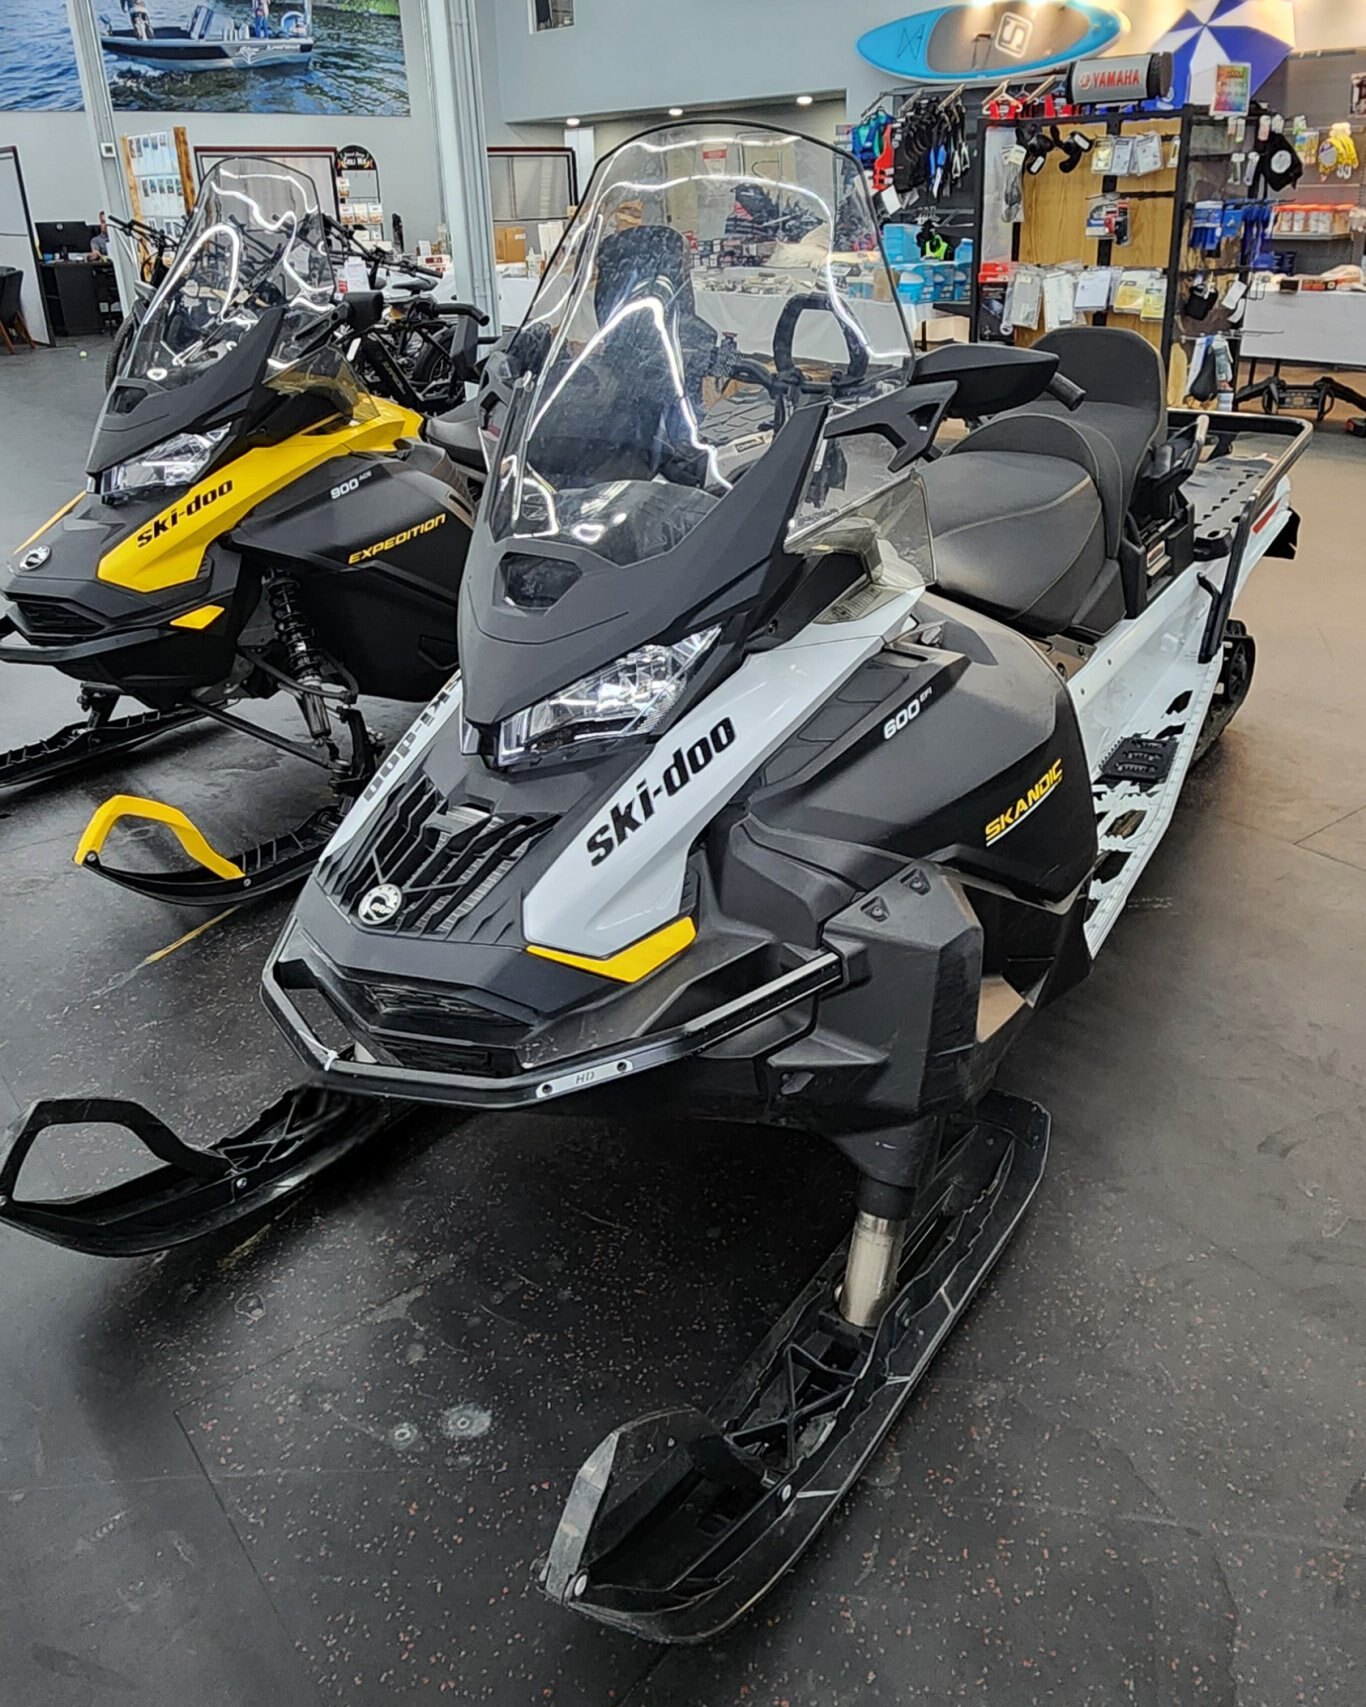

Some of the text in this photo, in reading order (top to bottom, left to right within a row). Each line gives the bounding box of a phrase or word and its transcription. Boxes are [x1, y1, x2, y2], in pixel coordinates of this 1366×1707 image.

[1092, 69, 1140, 88] YAMAHA
[330, 478, 359, 499] 900
[137, 479, 233, 548] ski-doo
[348, 513, 446, 564] EXPEDITION
[884, 698, 920, 740] 600
[586, 716, 737, 867] ski-doo
[985, 758, 1063, 842] SKANDIC
[575, 1071, 595, 1085] HD
